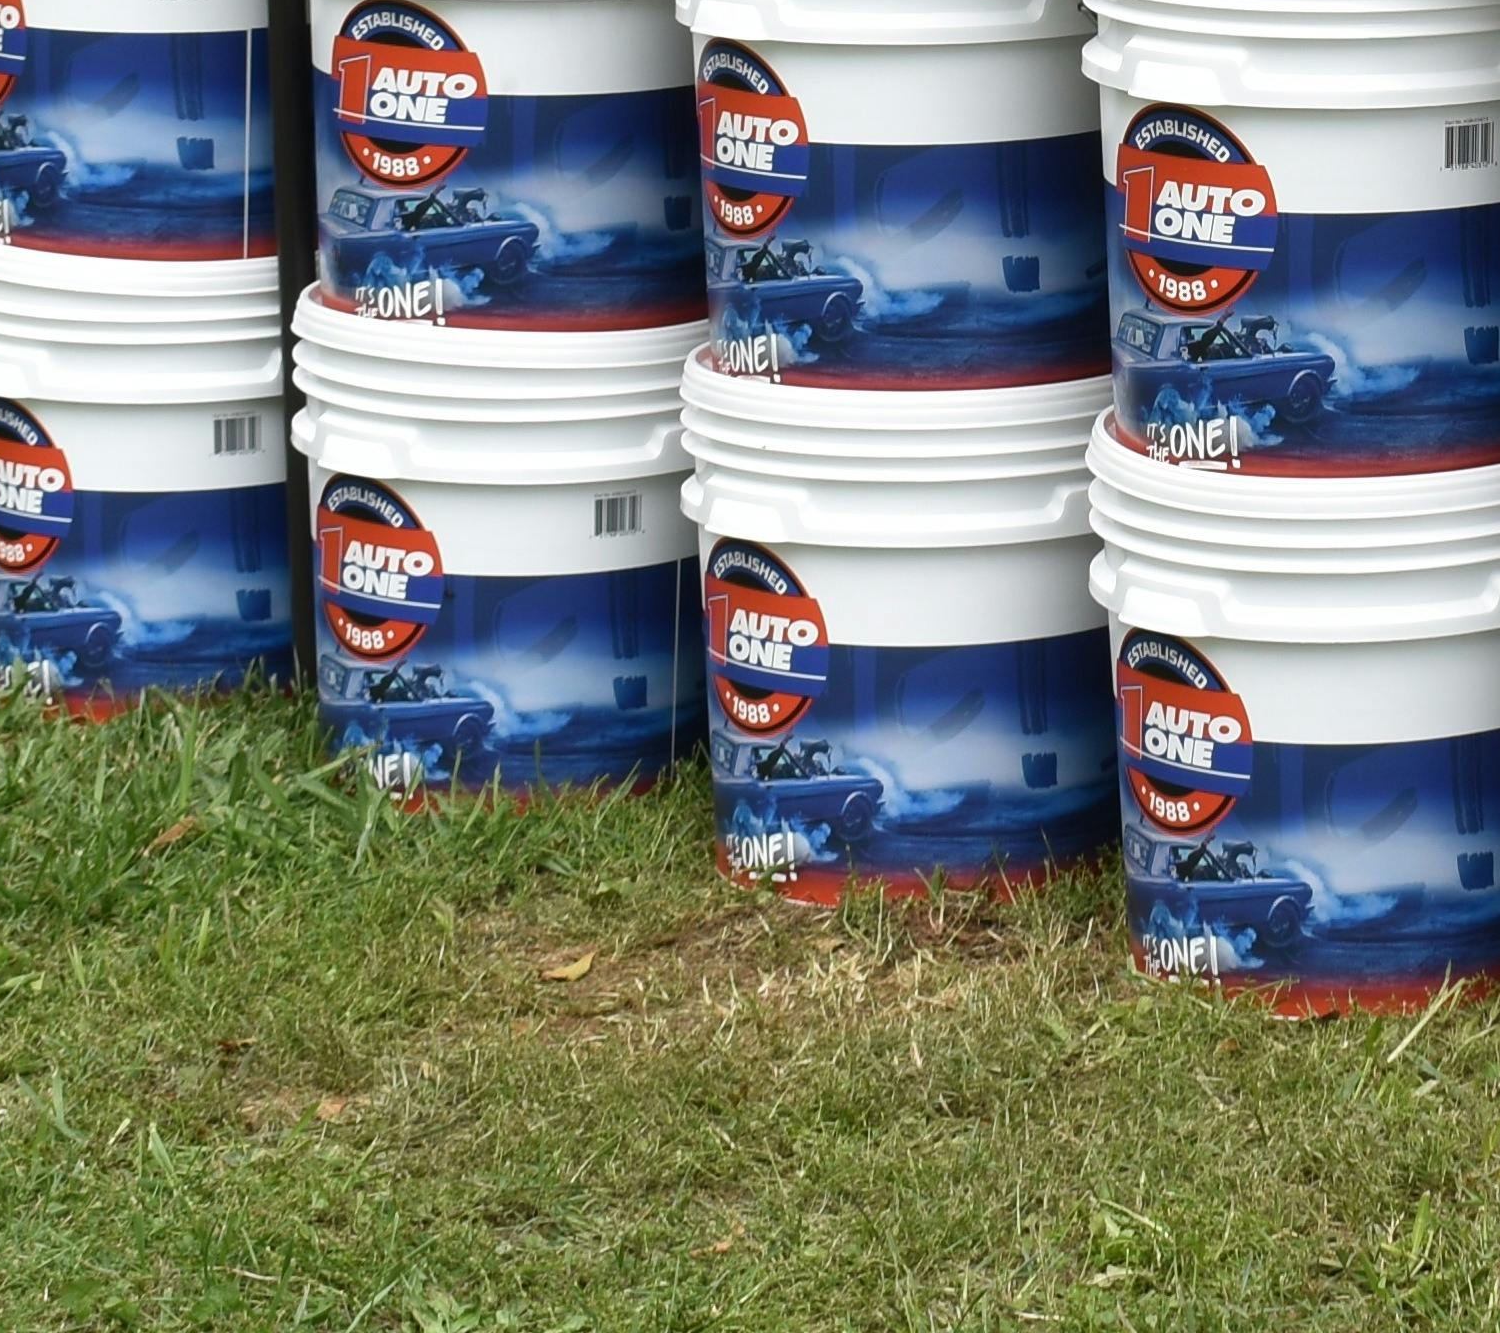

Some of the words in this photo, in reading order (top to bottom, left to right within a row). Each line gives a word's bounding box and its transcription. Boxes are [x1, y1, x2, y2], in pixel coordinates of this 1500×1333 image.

[372, 67, 477, 99] AUTO
[370, 93, 448, 124] ONE
[717, 110, 799, 145] AUTO
[1135, 119, 1230, 164] ESTABLISHED
[717, 140, 774, 171] ONE
[1156, 180, 1266, 217] AUTO
[1155, 208, 1236, 244] ONE
[378, 277, 445, 326] ONE!
[1158, 272, 1207, 302] 1988
[1146, 422, 1167, 443] IT'S
[1169, 415, 1240, 469] ONE!
[1146, 444, 1169, 464] THE
[344, 540, 433, 577] AUTO
[343, 564, 409, 601] ONE
[729, 608, 819, 647] AUTO
[729, 636, 792, 671] ONE
[1145, 701, 1241, 744] AUTO
[1145, 733, 1214, 769] ONE
